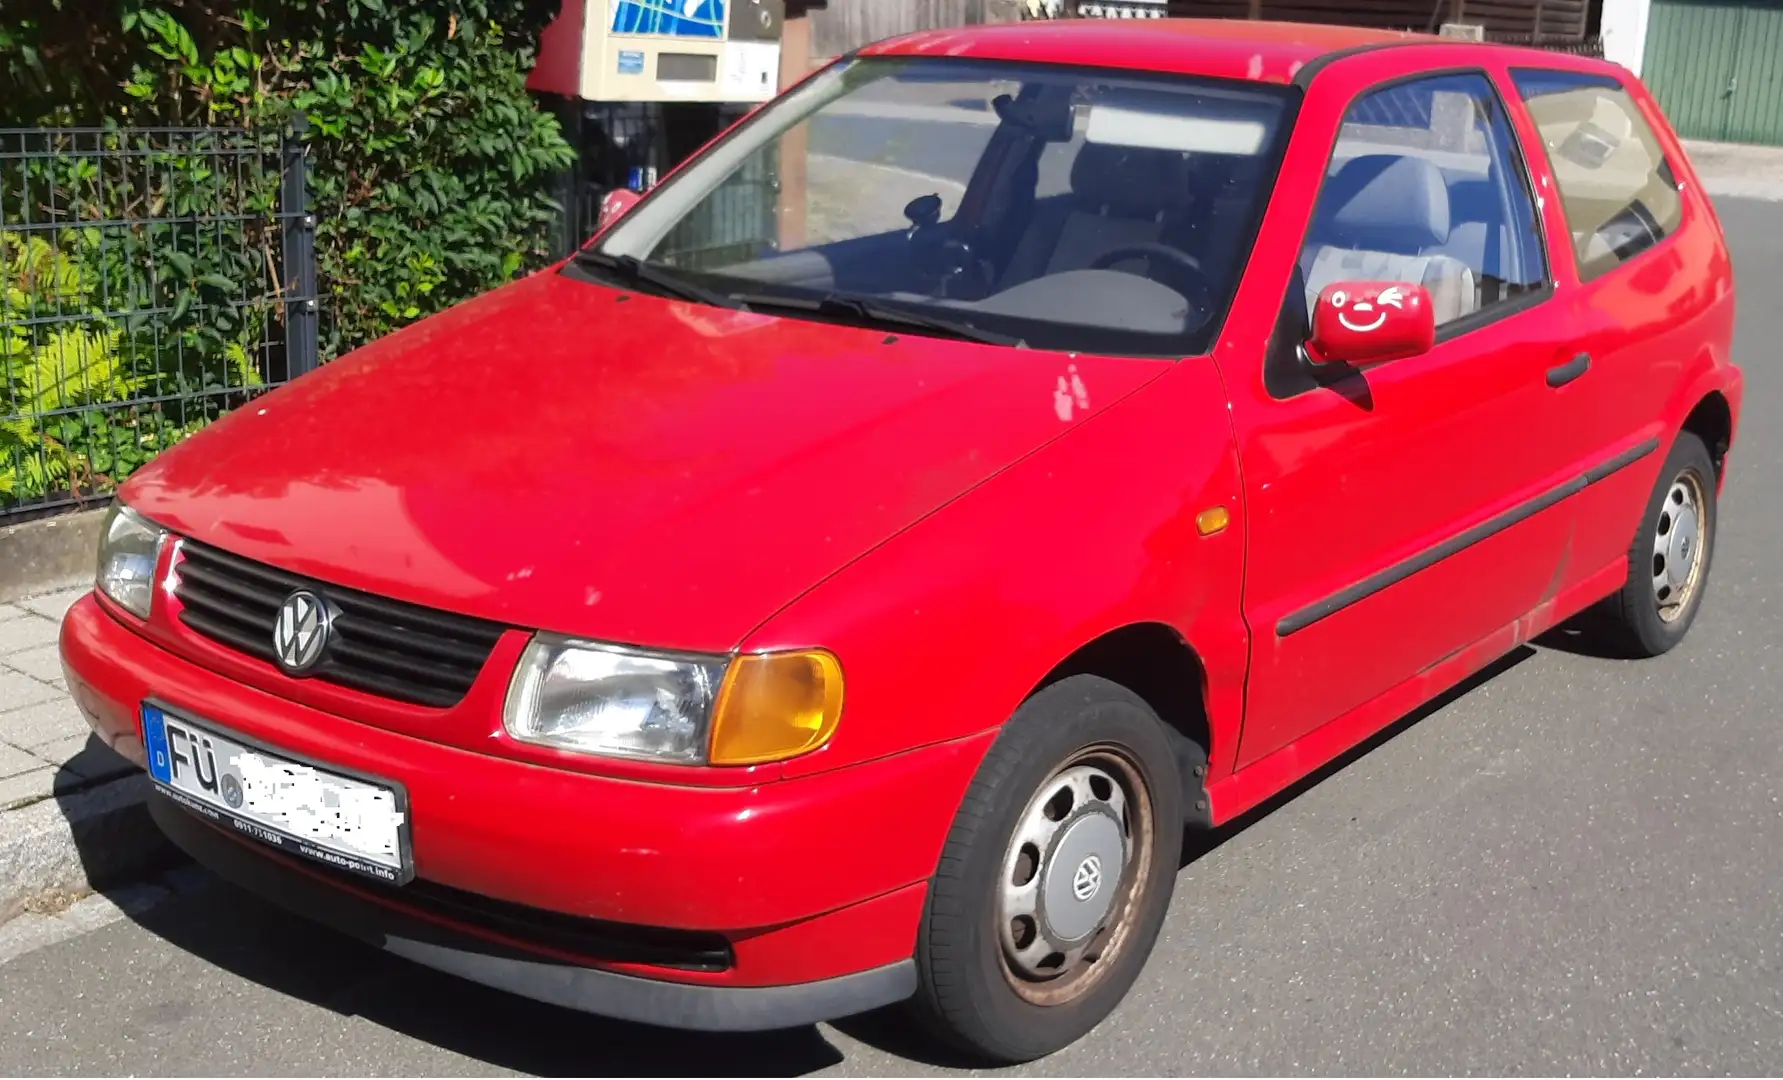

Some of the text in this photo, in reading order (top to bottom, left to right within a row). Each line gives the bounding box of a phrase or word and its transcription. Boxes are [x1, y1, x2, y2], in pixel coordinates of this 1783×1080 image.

[274, 591, 328, 669] VW
[156, 749, 165, 768] D
[166, 724, 219, 796] FÜ
